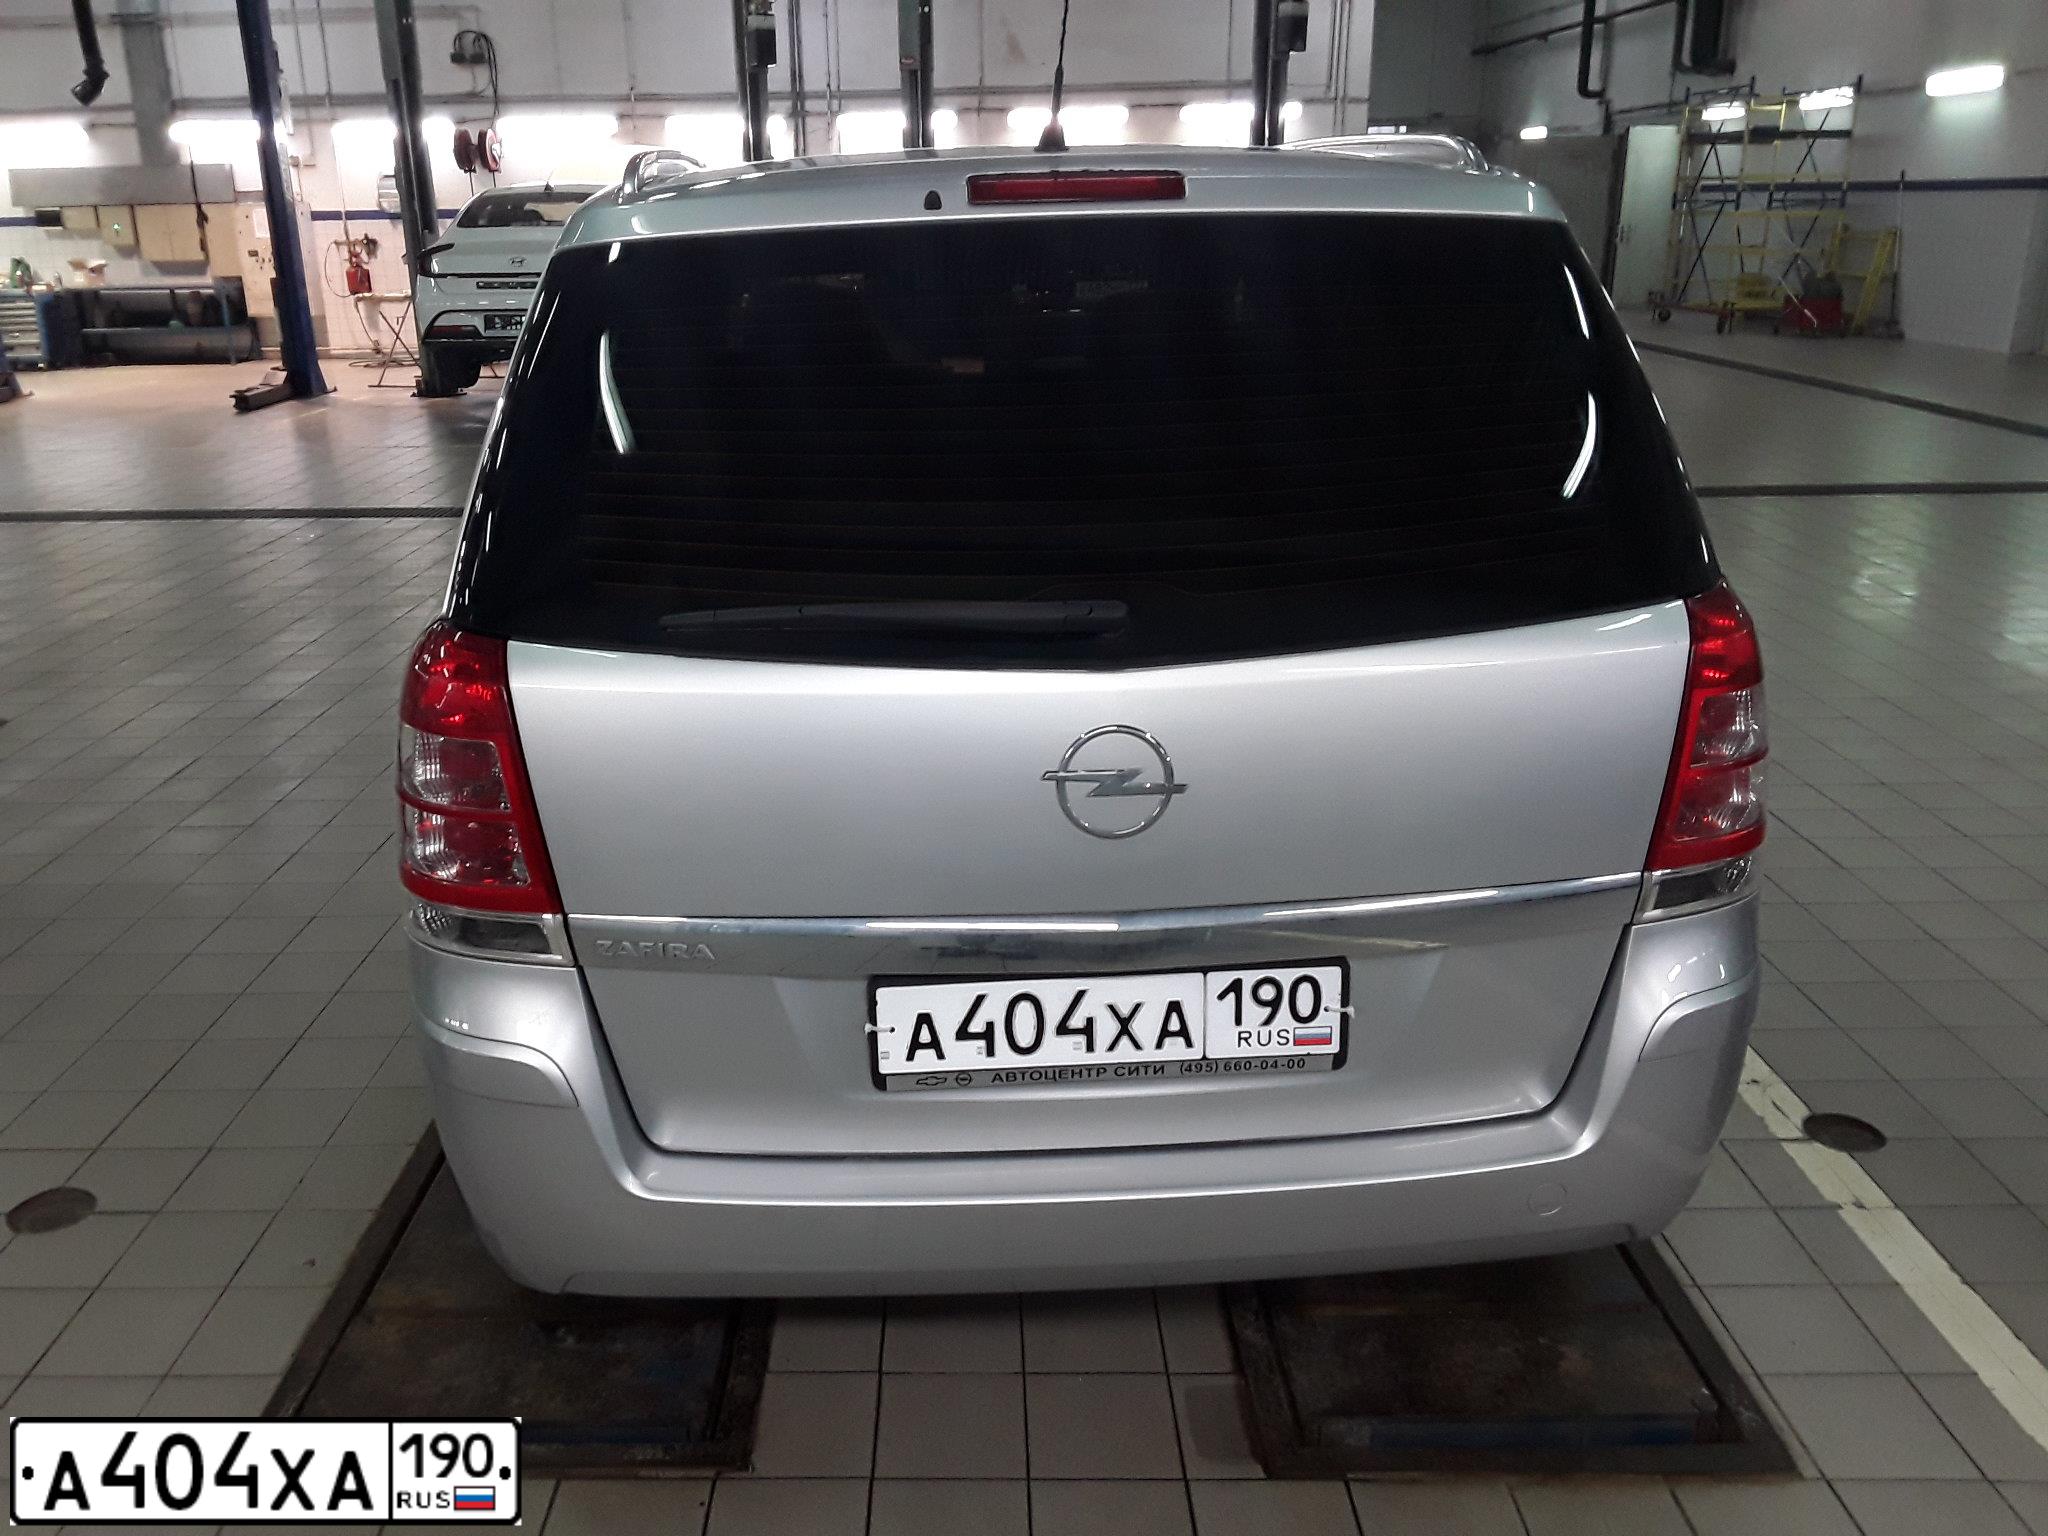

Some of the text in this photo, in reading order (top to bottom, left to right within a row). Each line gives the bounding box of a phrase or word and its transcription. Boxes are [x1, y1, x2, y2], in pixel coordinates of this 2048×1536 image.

[595, 939, 716, 961] ZAFIRA
[1216, 974, 1323, 1027] 190
[905, 989, 1194, 1062] А404ХА
[1237, 1028, 1291, 1048] RUS
[990, 1057, 1306, 1084] АВТОЦЕНТР СИТИ (495) 660-04-00
